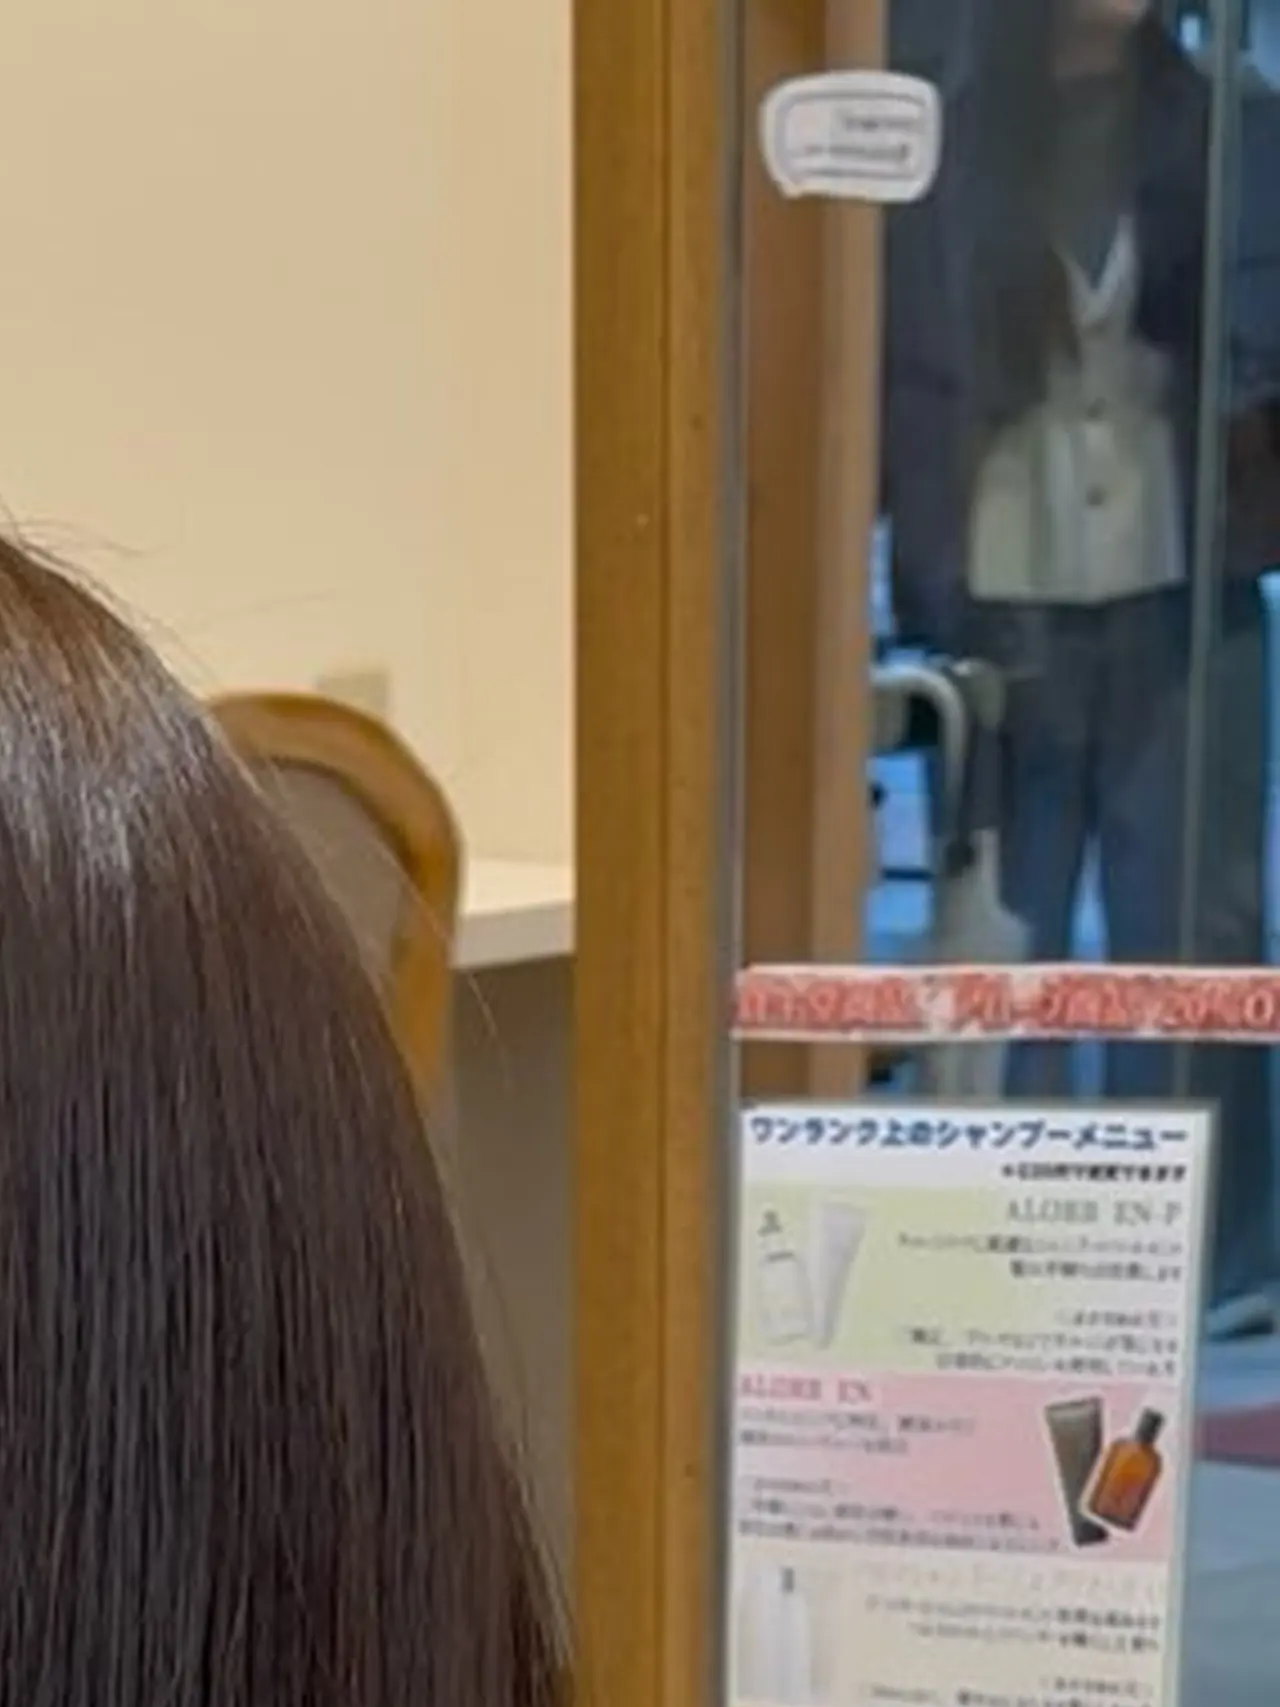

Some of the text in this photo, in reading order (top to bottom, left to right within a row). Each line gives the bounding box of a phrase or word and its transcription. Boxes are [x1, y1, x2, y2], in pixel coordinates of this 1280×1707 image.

[749, 1116, 1189, 1150] ワンランク上のシャンプーメニュー
